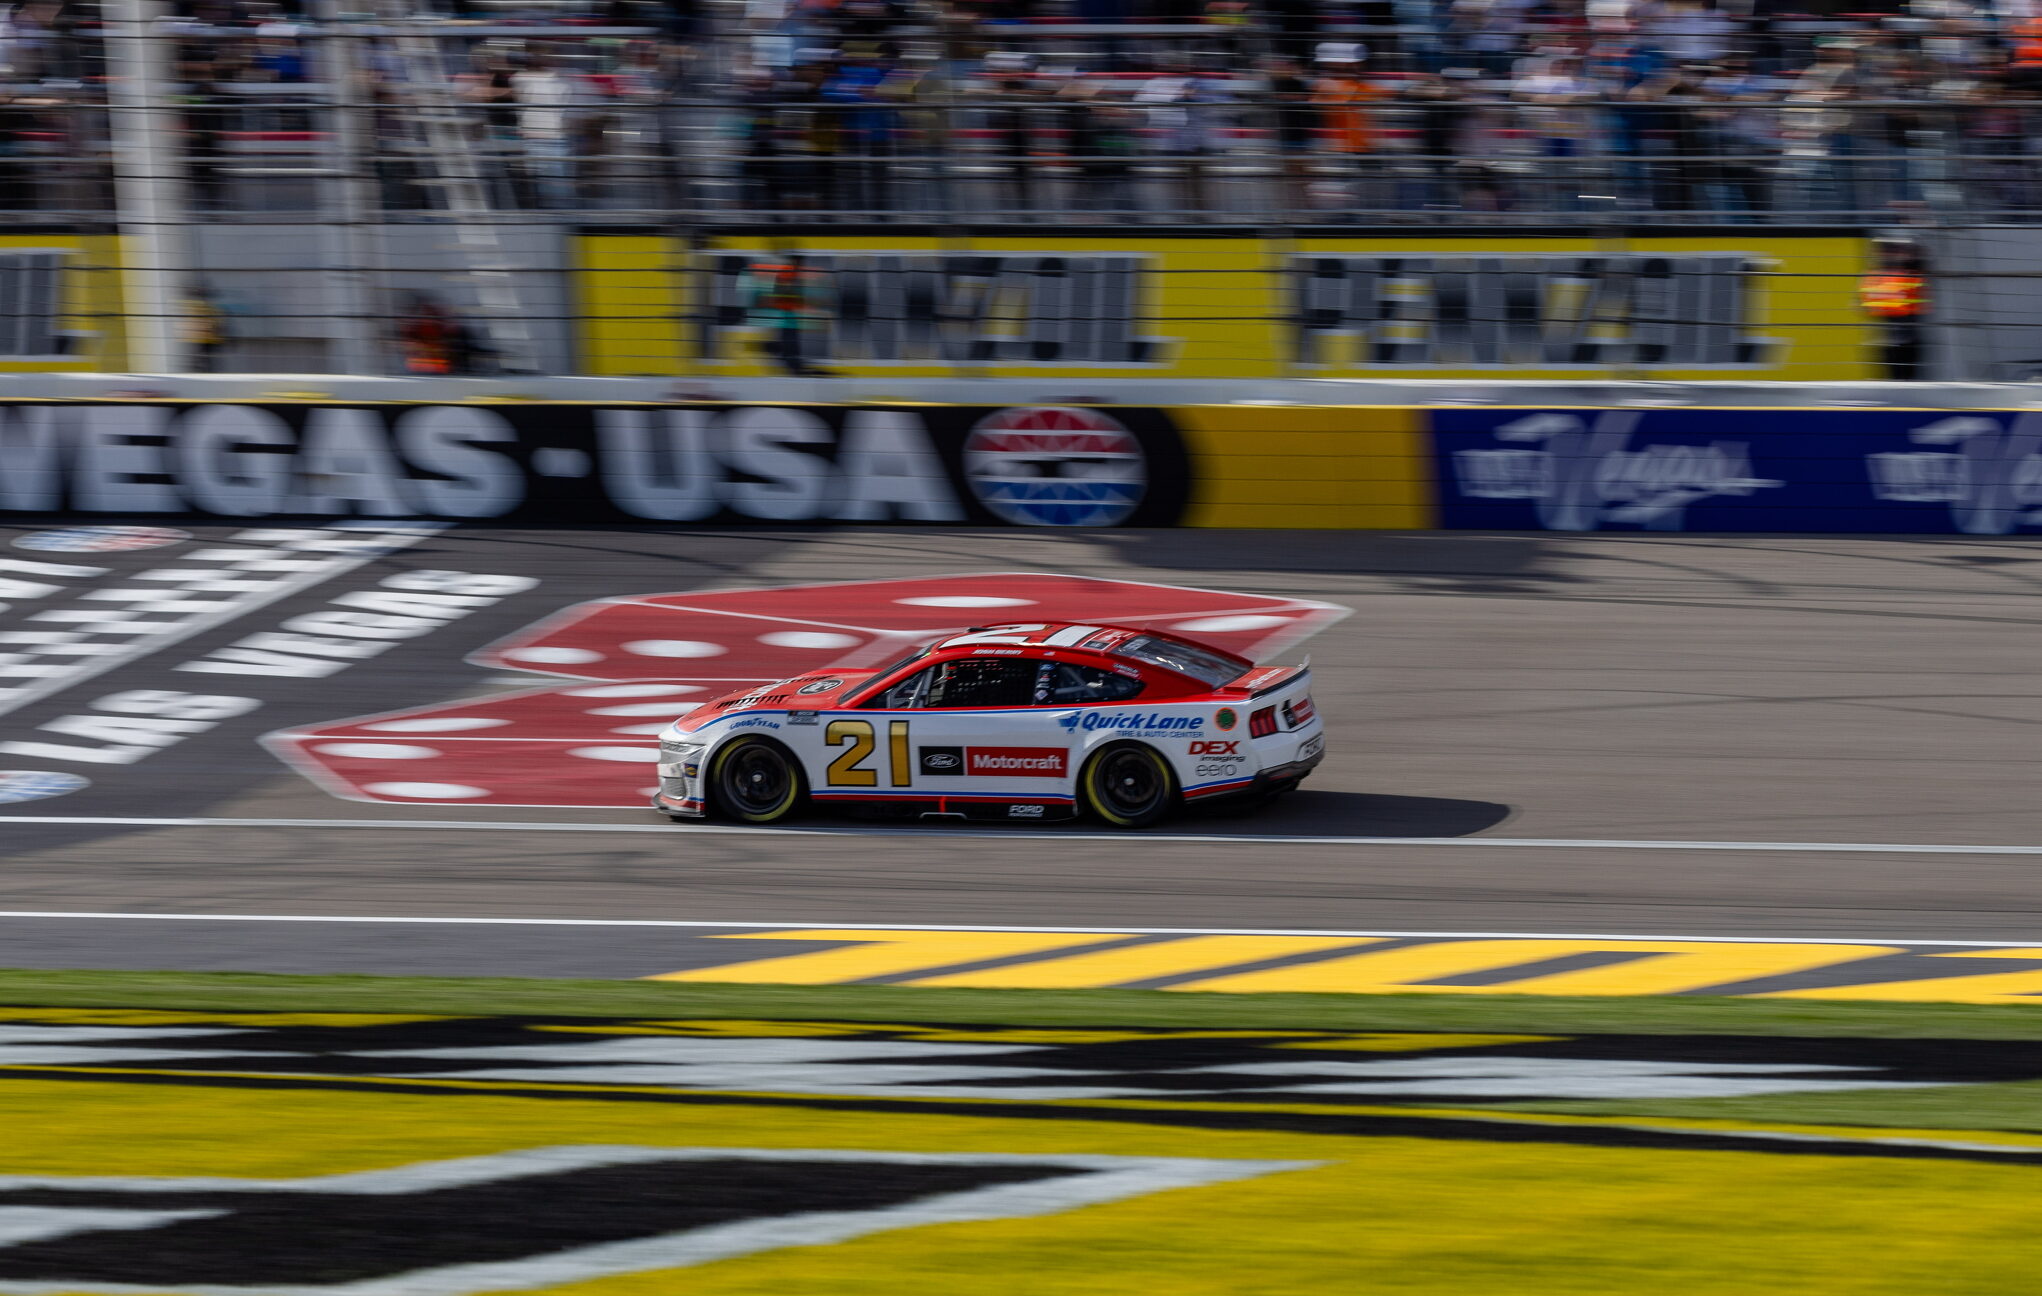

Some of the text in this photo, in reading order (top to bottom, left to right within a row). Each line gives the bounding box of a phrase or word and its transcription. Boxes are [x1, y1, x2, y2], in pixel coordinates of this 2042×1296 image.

[592, 406, 968, 522] USA
[937, 623, 1103, 648] 21
[825, 719, 911, 787] 21
[1188, 740, 1240, 755] DEX
[973, 754, 1062, 770] Motorcraft
[1195, 764, 1238, 777] eero
[1009, 805, 1045, 813] FORD
